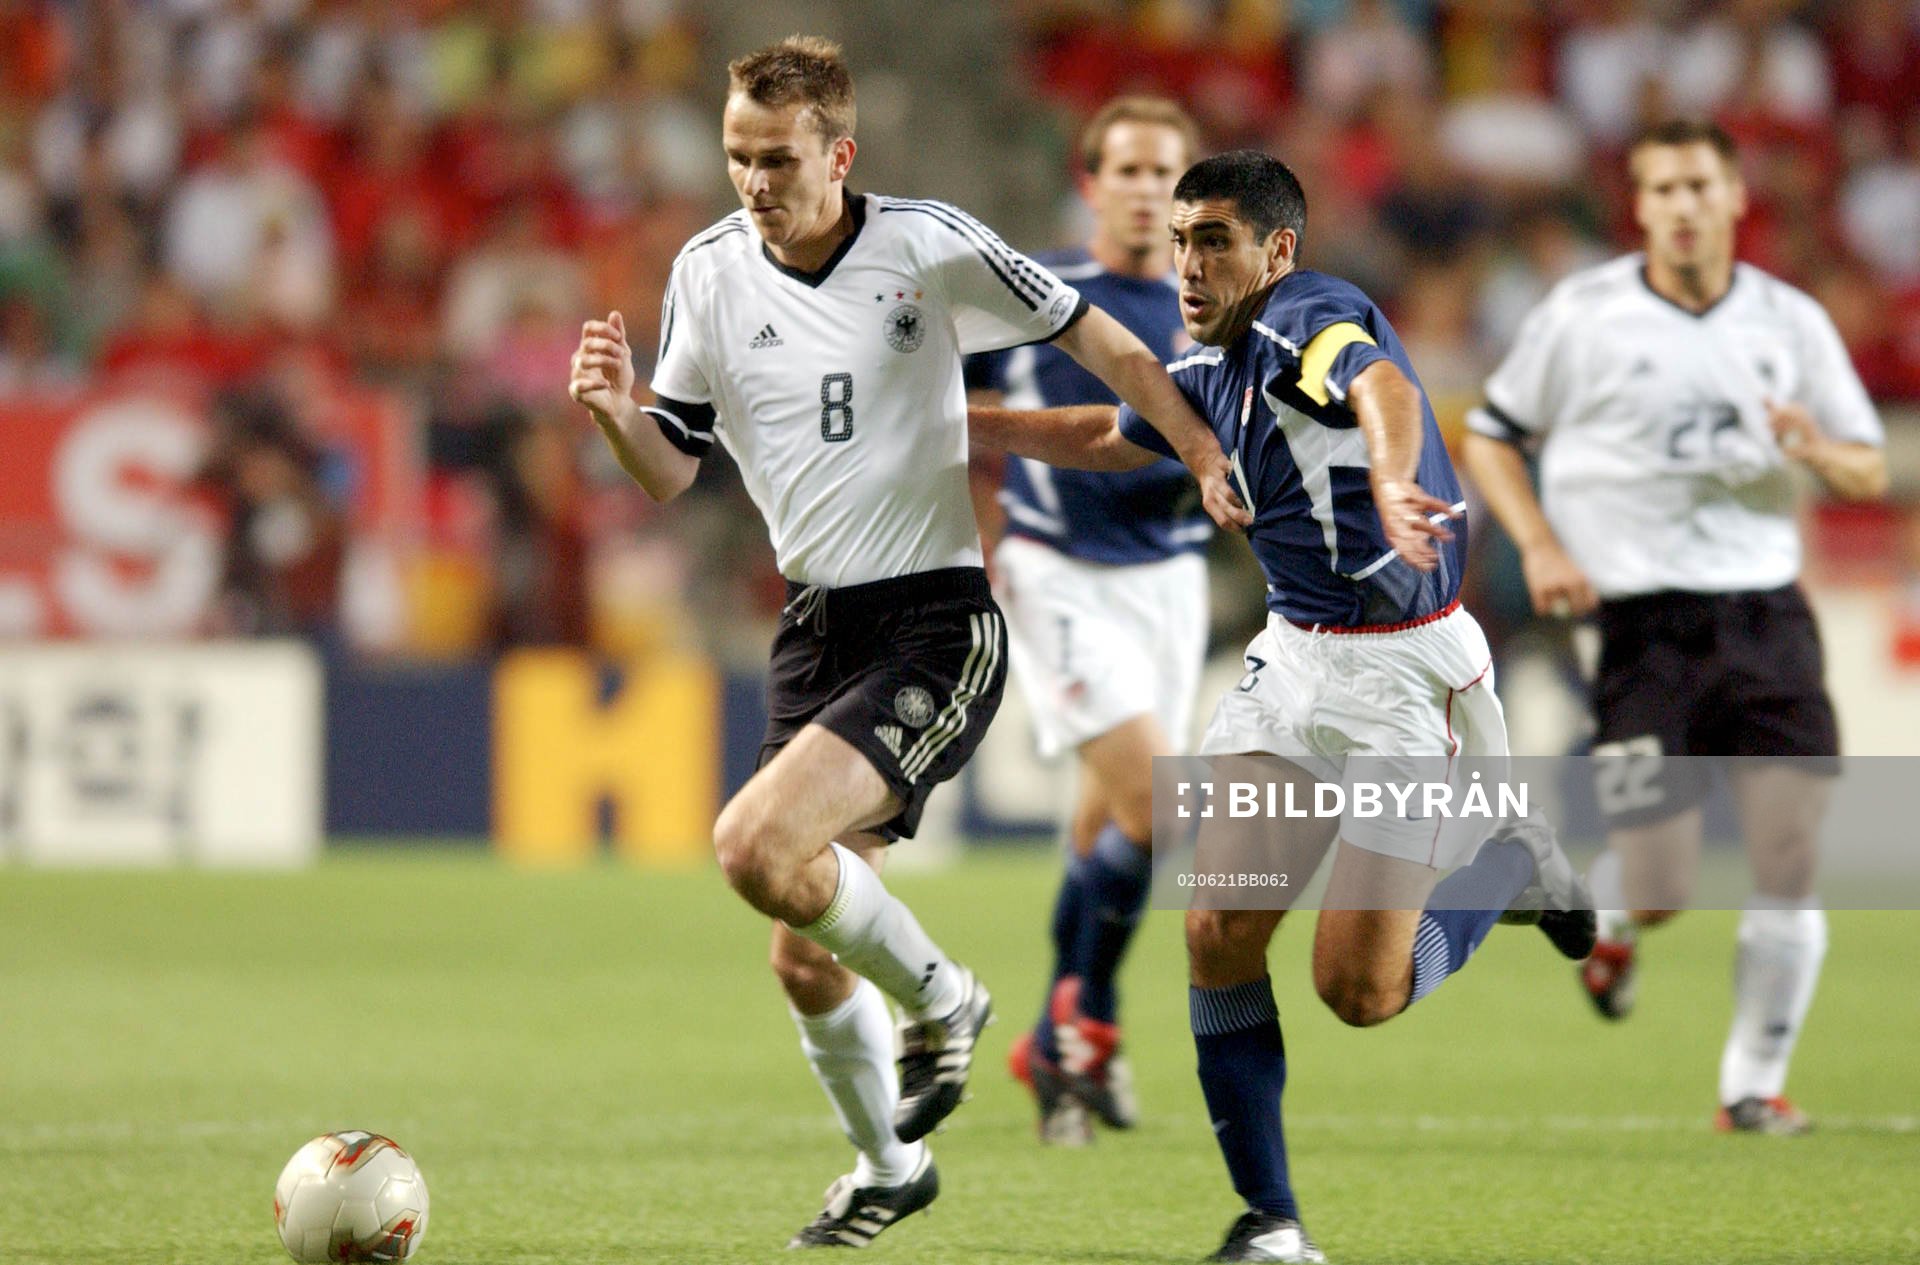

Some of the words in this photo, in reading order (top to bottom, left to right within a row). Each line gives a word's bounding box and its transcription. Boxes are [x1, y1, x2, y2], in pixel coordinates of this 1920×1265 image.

[748, 338, 785, 350] adidas
[820, 371, 854, 443] 8
[494, 645, 722, 870] H
[1591, 735, 1664, 816] 22
